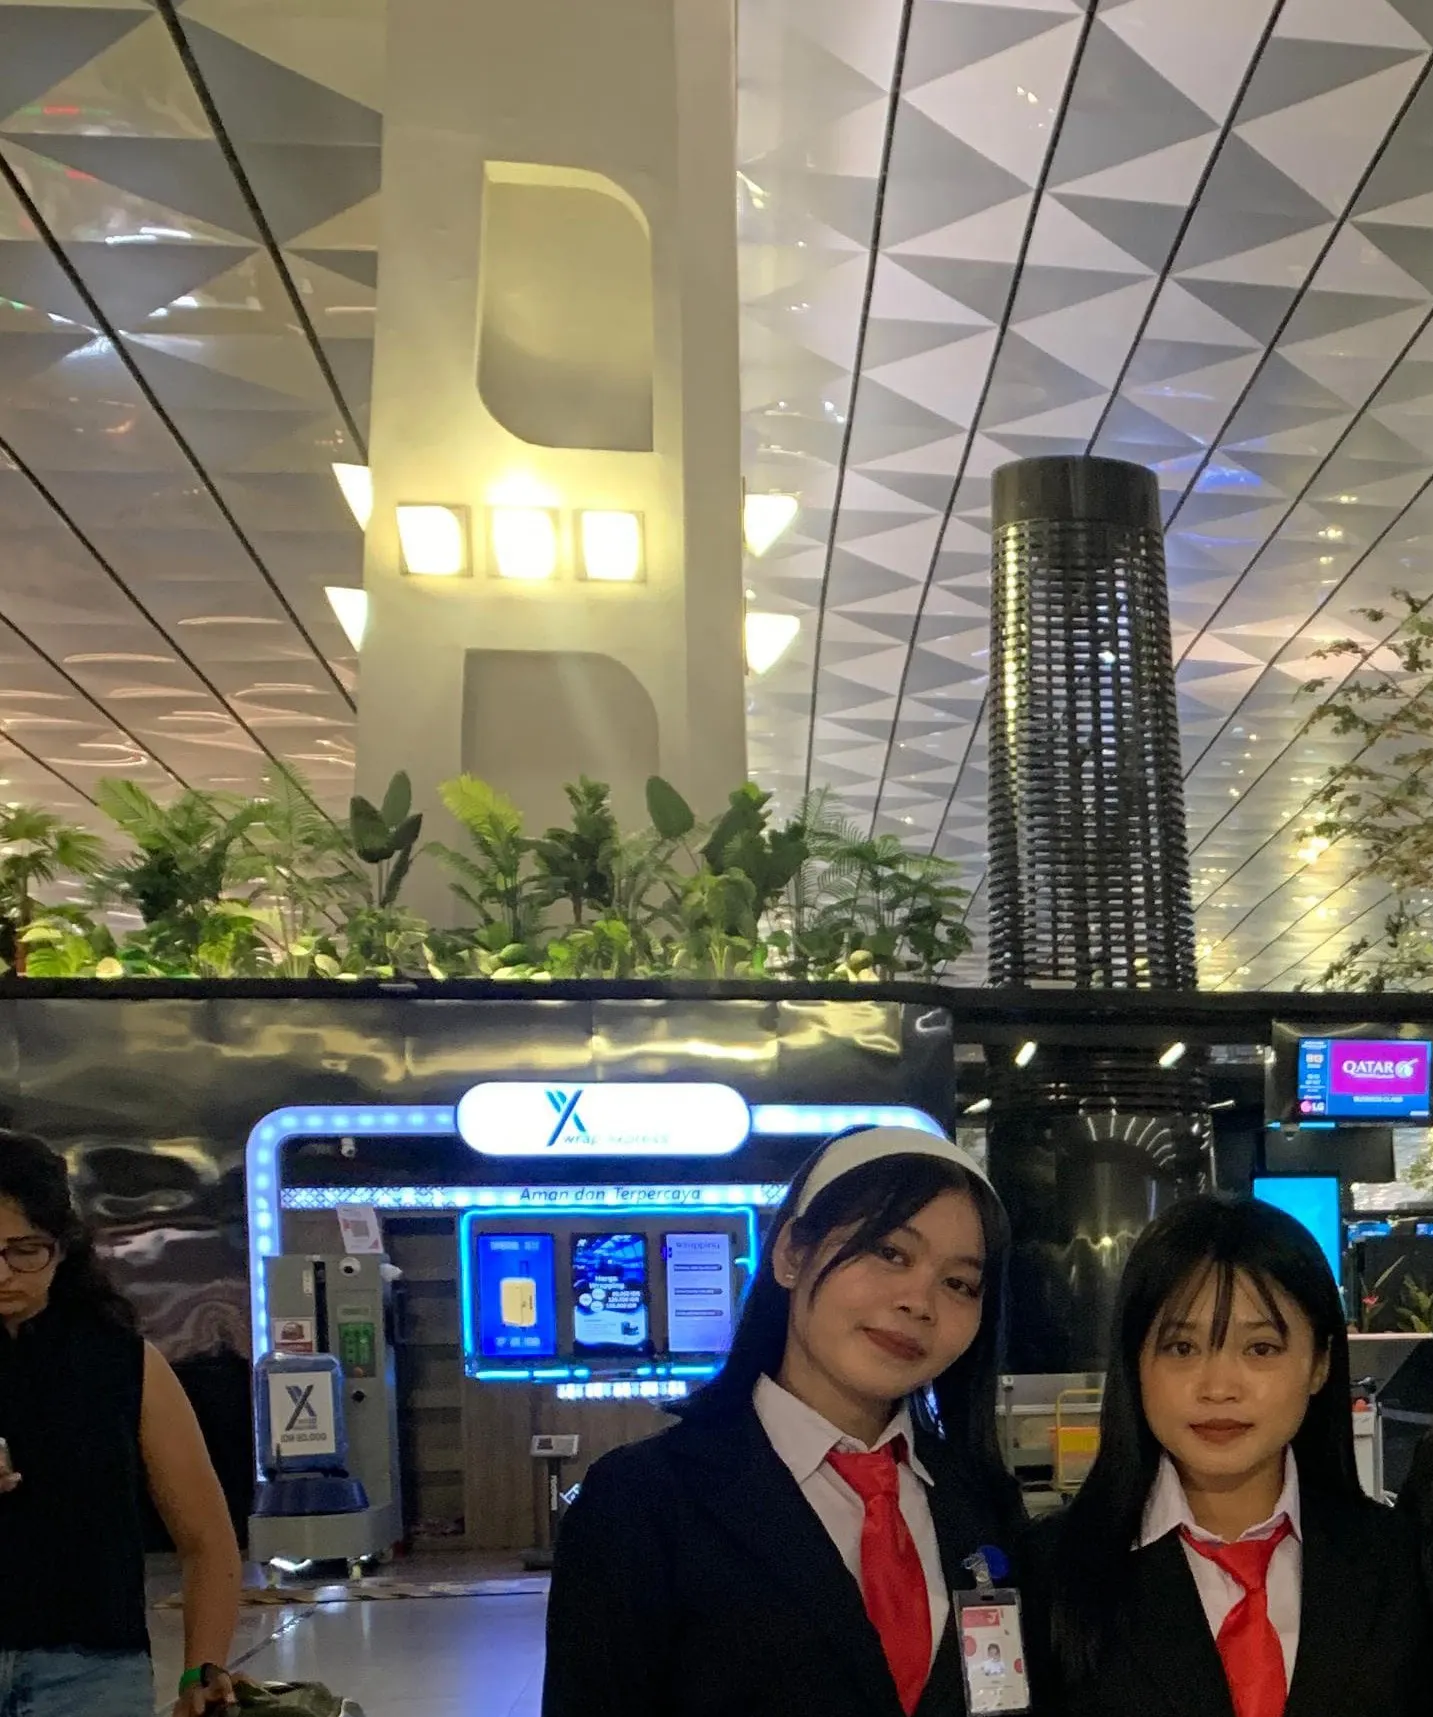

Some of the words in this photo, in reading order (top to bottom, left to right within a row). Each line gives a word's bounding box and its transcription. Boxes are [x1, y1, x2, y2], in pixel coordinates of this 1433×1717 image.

[1342, 1060, 1395, 1075] QATAR
[1312, 1101, 1325, 1112] LG
[519, 1187, 570, 1201] Aman
[575, 1187, 605, 1201] dan
[613, 1187, 701, 1204] Terpercaya
